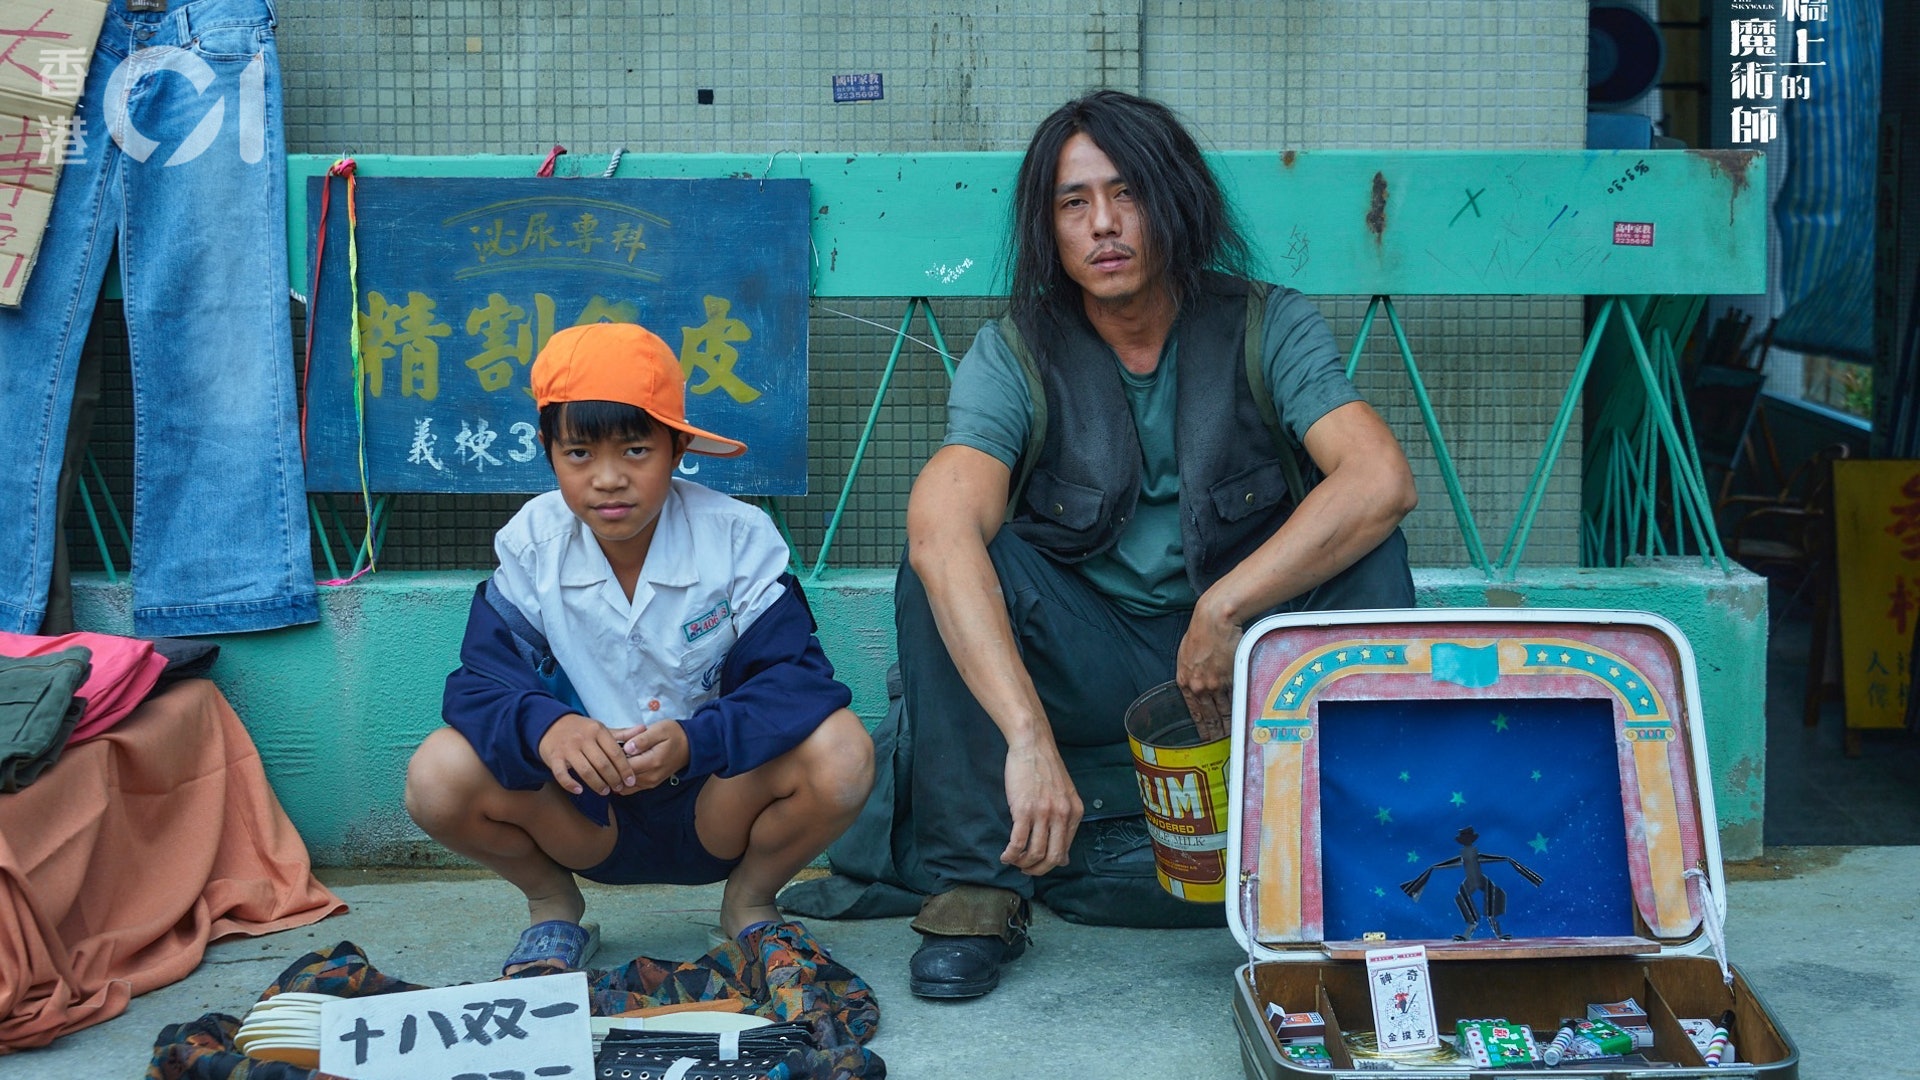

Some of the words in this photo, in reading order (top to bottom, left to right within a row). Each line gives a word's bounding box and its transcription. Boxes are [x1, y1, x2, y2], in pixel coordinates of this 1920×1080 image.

[469, 211, 647, 263] 泌尿專科
[352, 291, 762, 403] 精割皮
